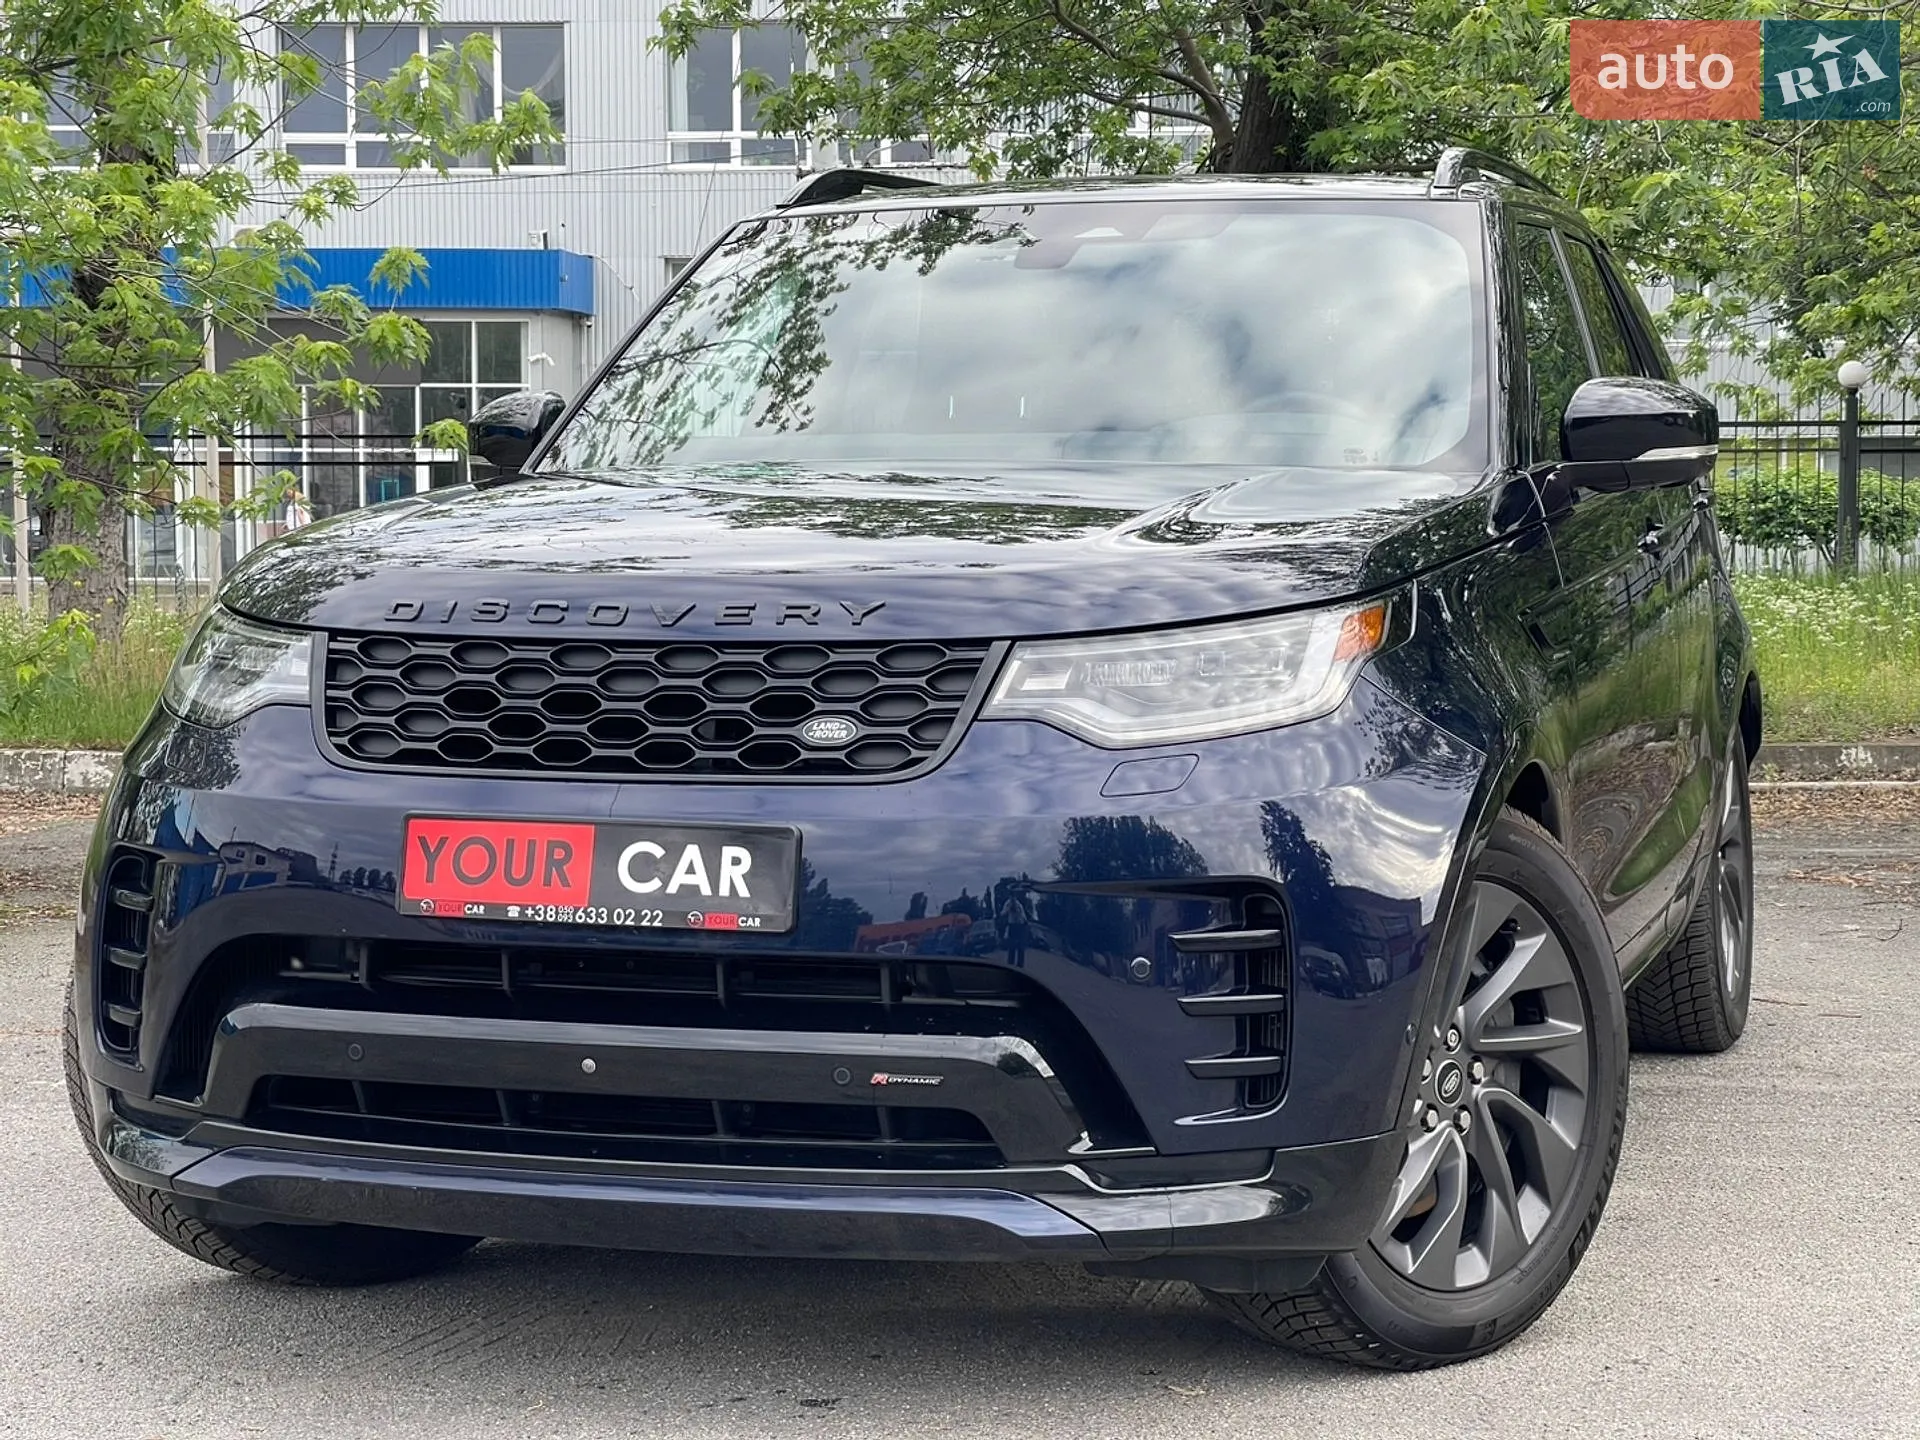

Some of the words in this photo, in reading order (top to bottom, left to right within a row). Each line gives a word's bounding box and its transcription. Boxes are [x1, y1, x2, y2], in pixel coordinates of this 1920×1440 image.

[384, 599, 886, 627] DISCOVERY
[812, 721, 841, 731] LAND
[813, 730, 848, 739] ROVER
[417, 835, 573, 888] YOUR
[617, 841, 753, 898] CAR
[437, 902, 463, 914] YOUR
[464, 903, 485, 915] CAR
[525, 904, 556, 922] +38
[575, 906, 608, 924] 633
[613, 908, 635, 926] 02
[640, 909, 664, 927] 22
[707, 914, 735, 926] YOUR
[738, 916, 761, 927] CAR
[888, 1076, 942, 1085] DYNAMIC
